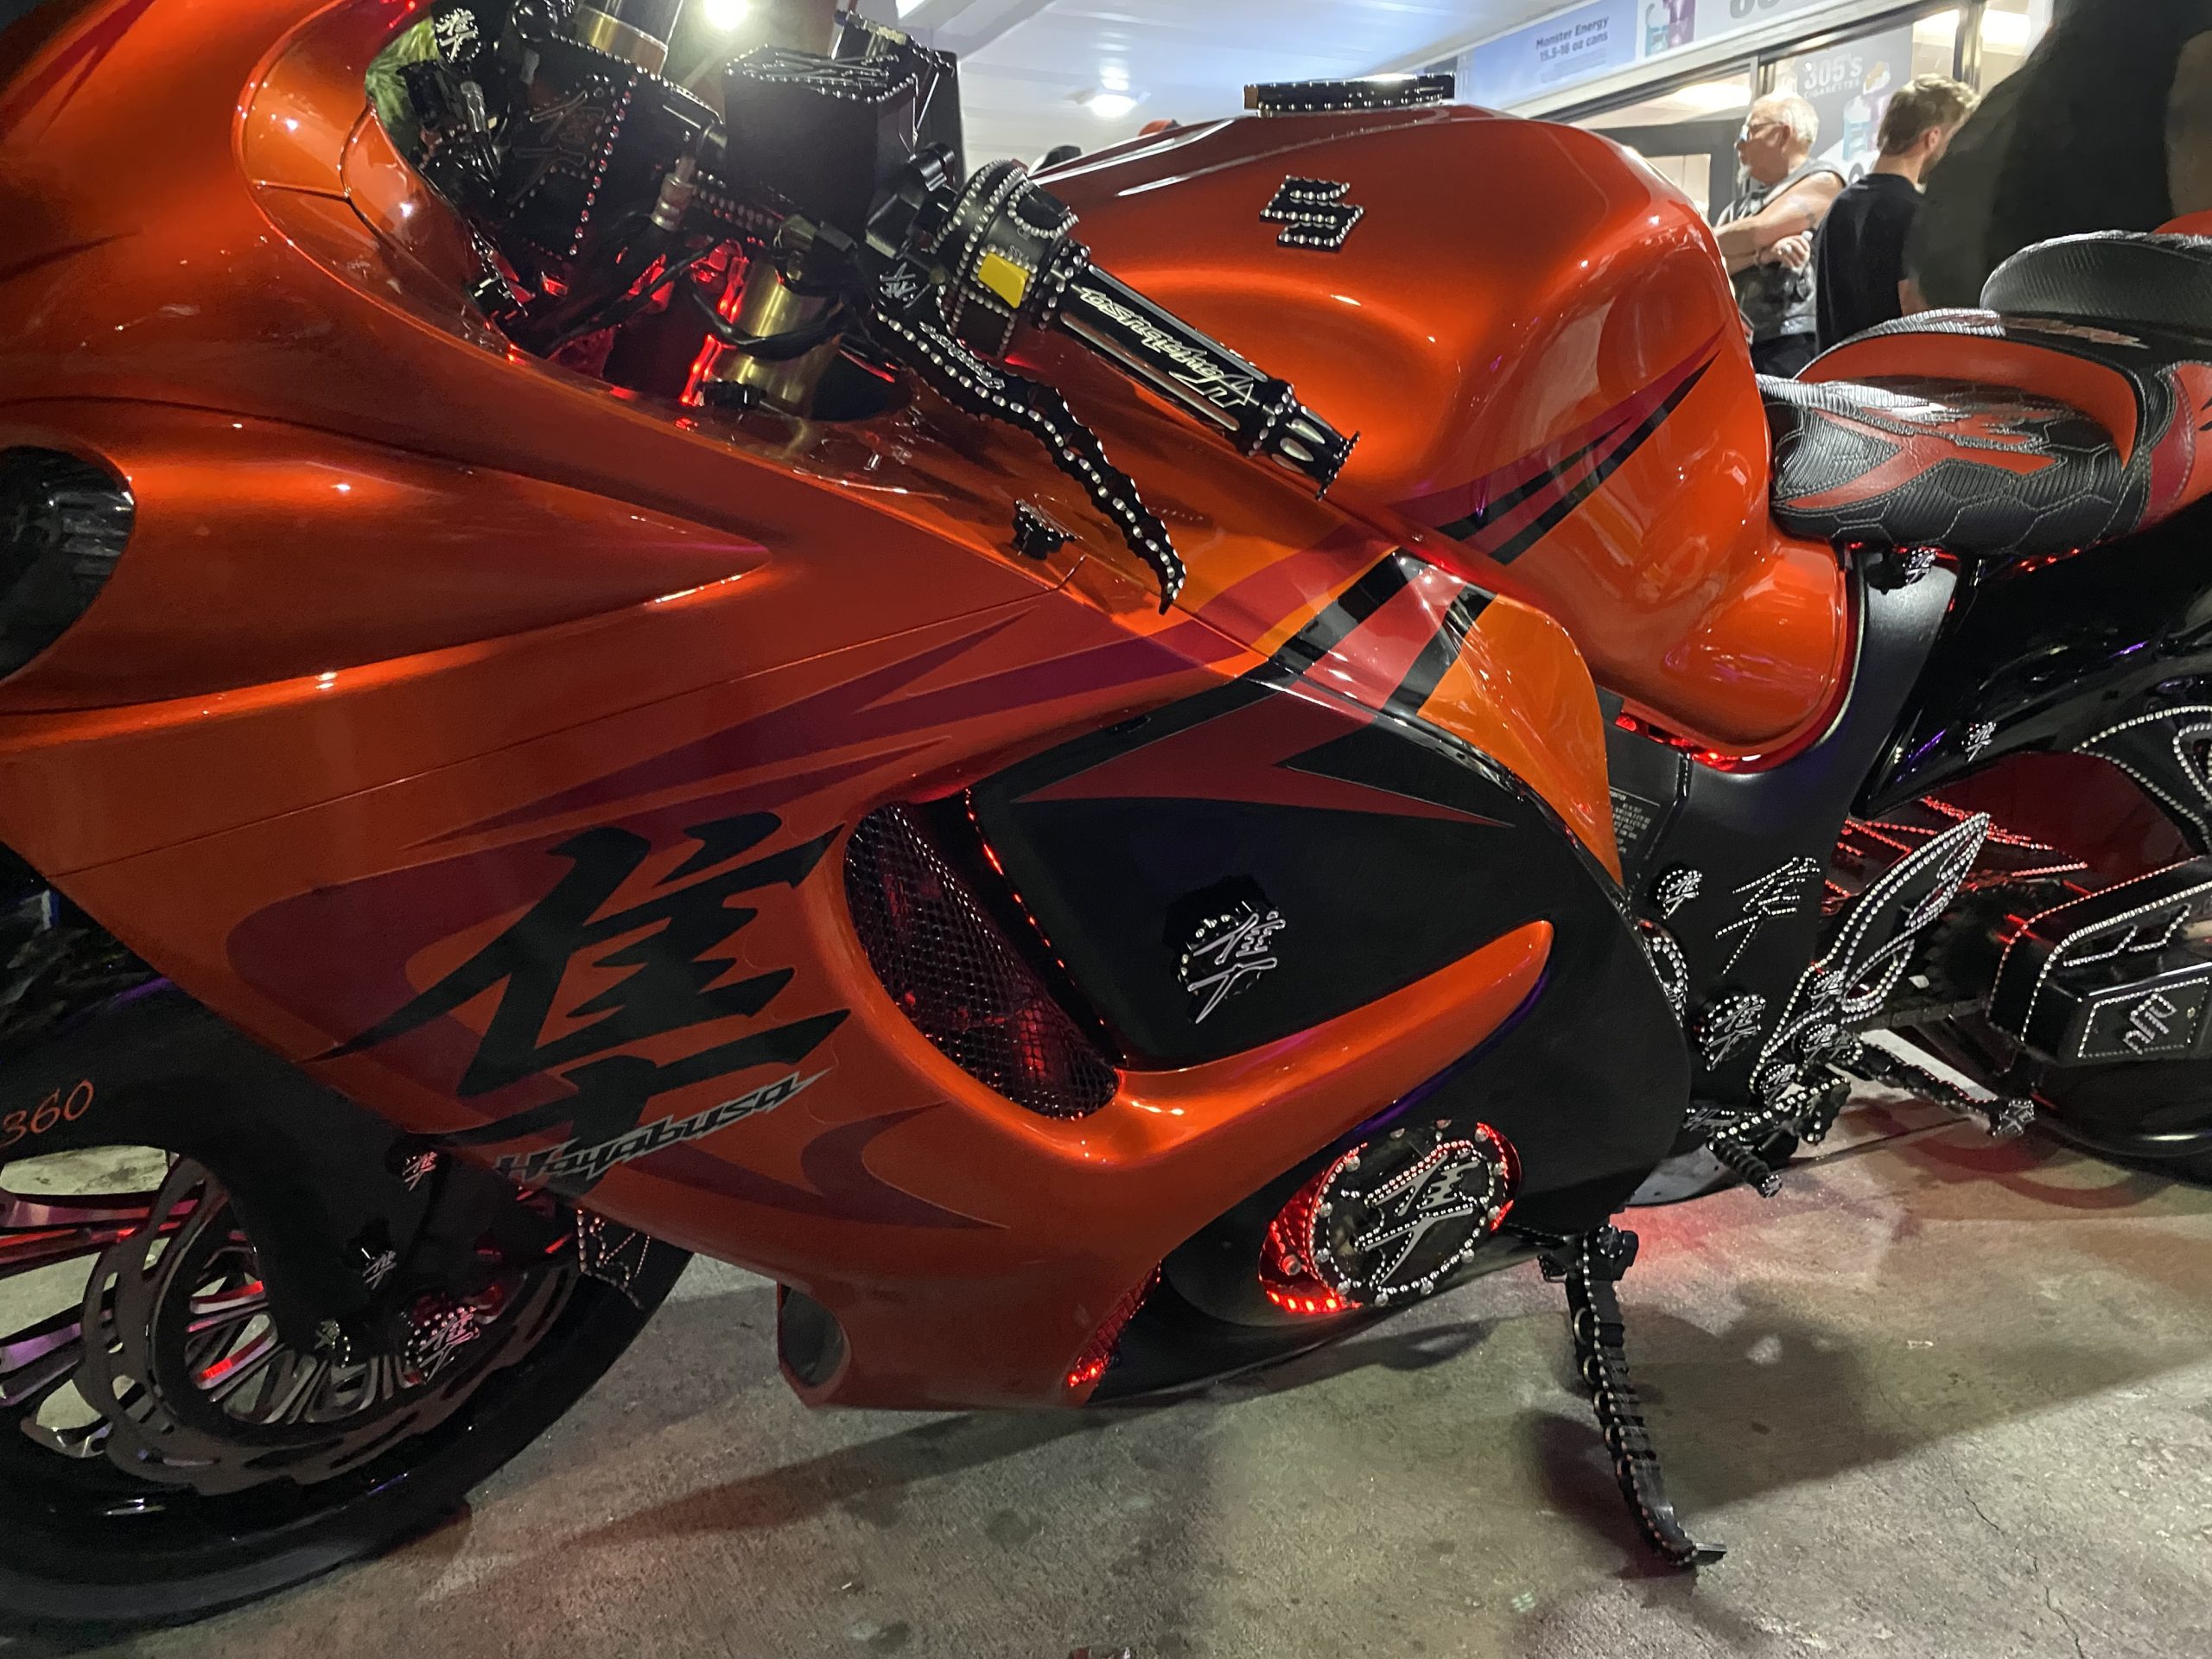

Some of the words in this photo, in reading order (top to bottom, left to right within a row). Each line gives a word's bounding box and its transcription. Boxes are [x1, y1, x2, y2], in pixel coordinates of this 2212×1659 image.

[1535, 29, 1573, 49] Monster
[1575, 16, 1610, 36] Energy
[1586, 31, 1609, 47] cans
[493, 1066, 833, 1181] Hayabusa
